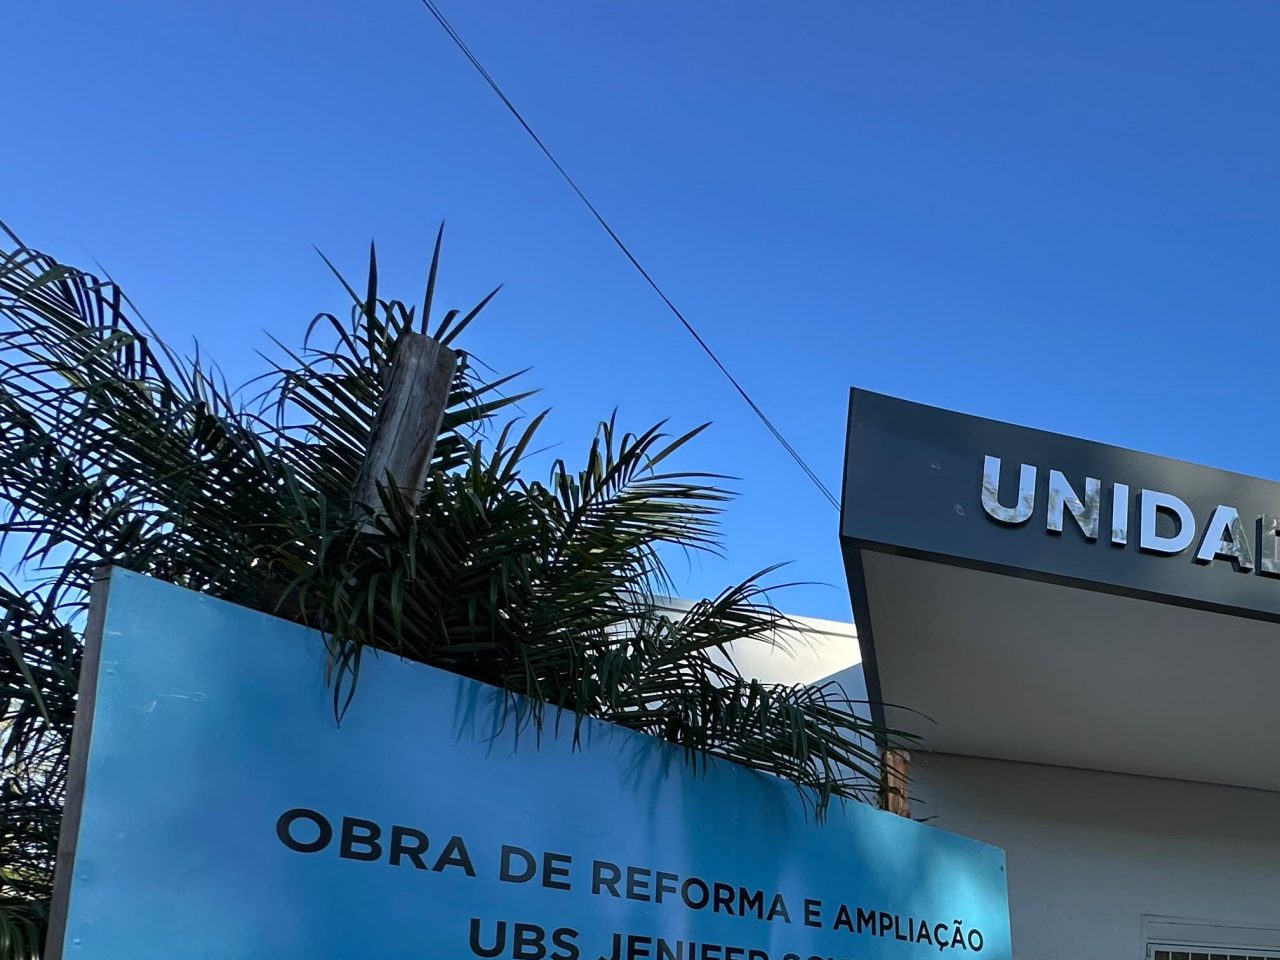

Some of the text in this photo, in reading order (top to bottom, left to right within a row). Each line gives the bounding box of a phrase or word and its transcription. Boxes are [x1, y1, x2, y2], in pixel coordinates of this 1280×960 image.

[276, 808, 984, 953] OBRA DE REFORMA E AMPLIAÇÃO
